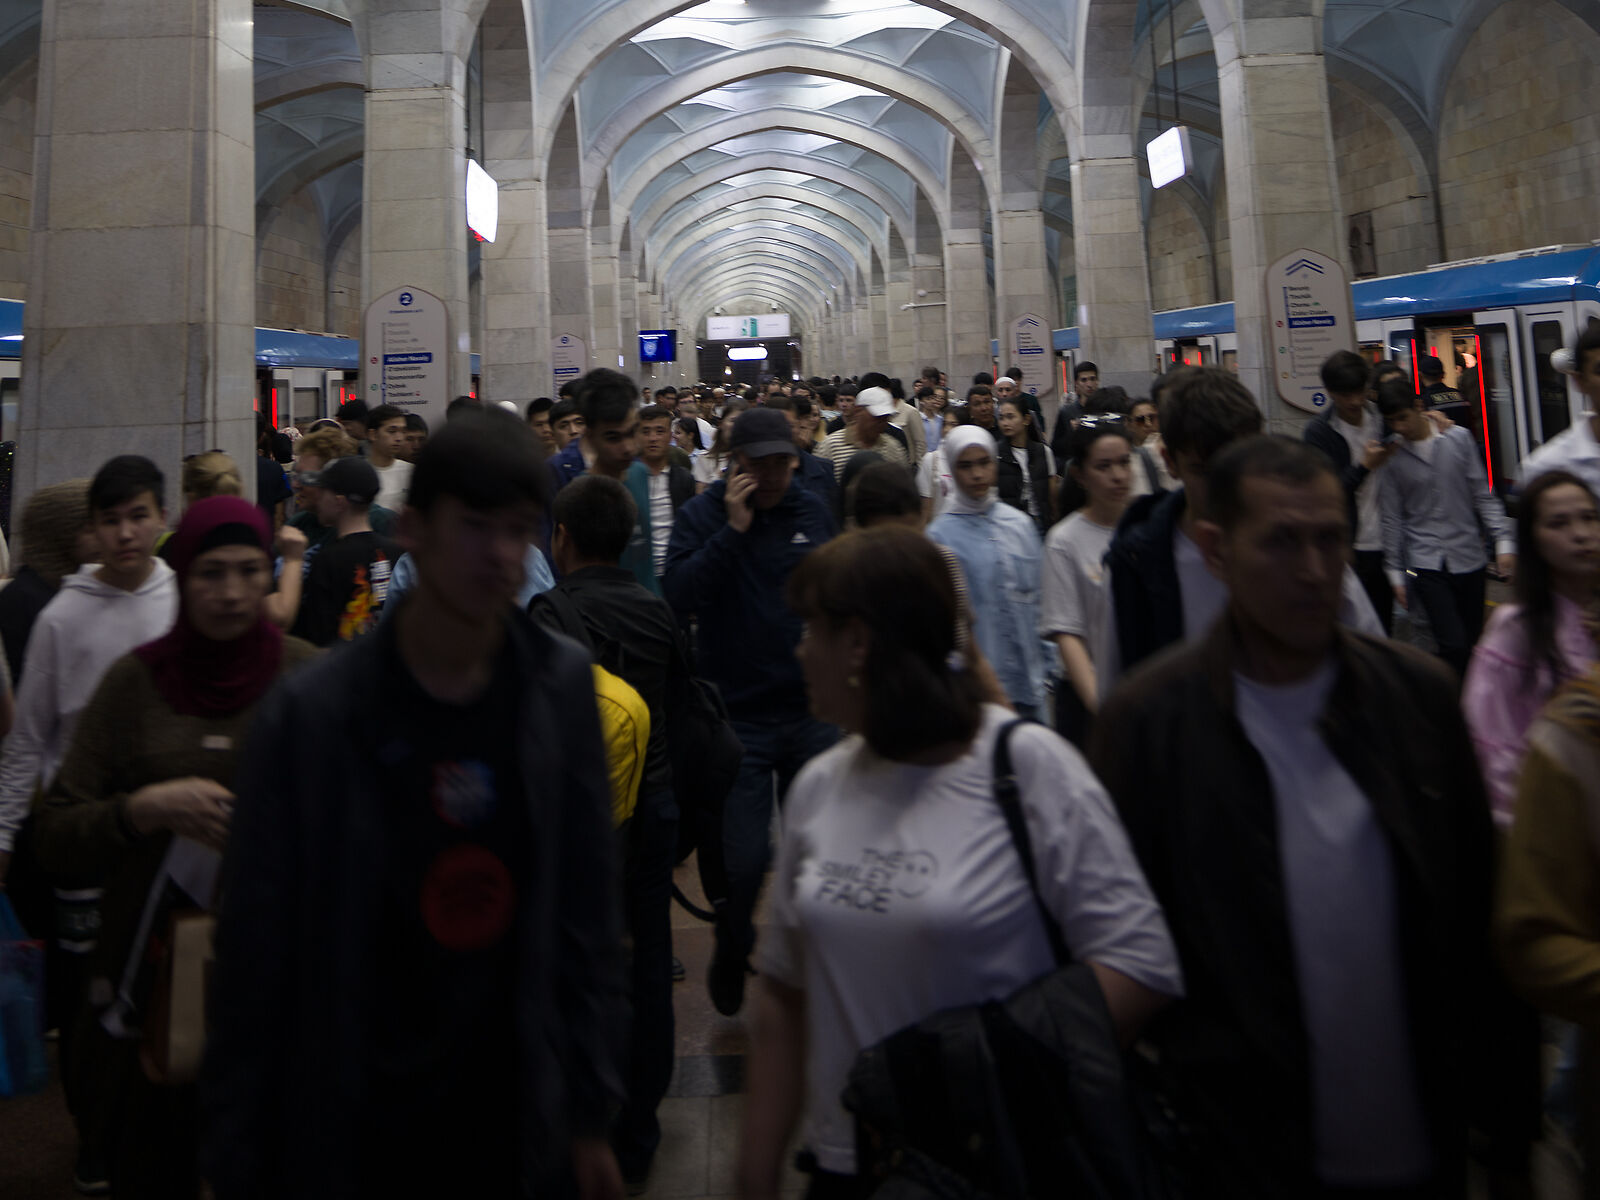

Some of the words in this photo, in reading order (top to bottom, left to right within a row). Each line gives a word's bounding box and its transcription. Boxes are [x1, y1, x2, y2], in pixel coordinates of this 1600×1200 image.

[862, 848, 904, 868] THE
[816, 861, 897, 885] SMILEY
[814, 880, 892, 913] FACE
